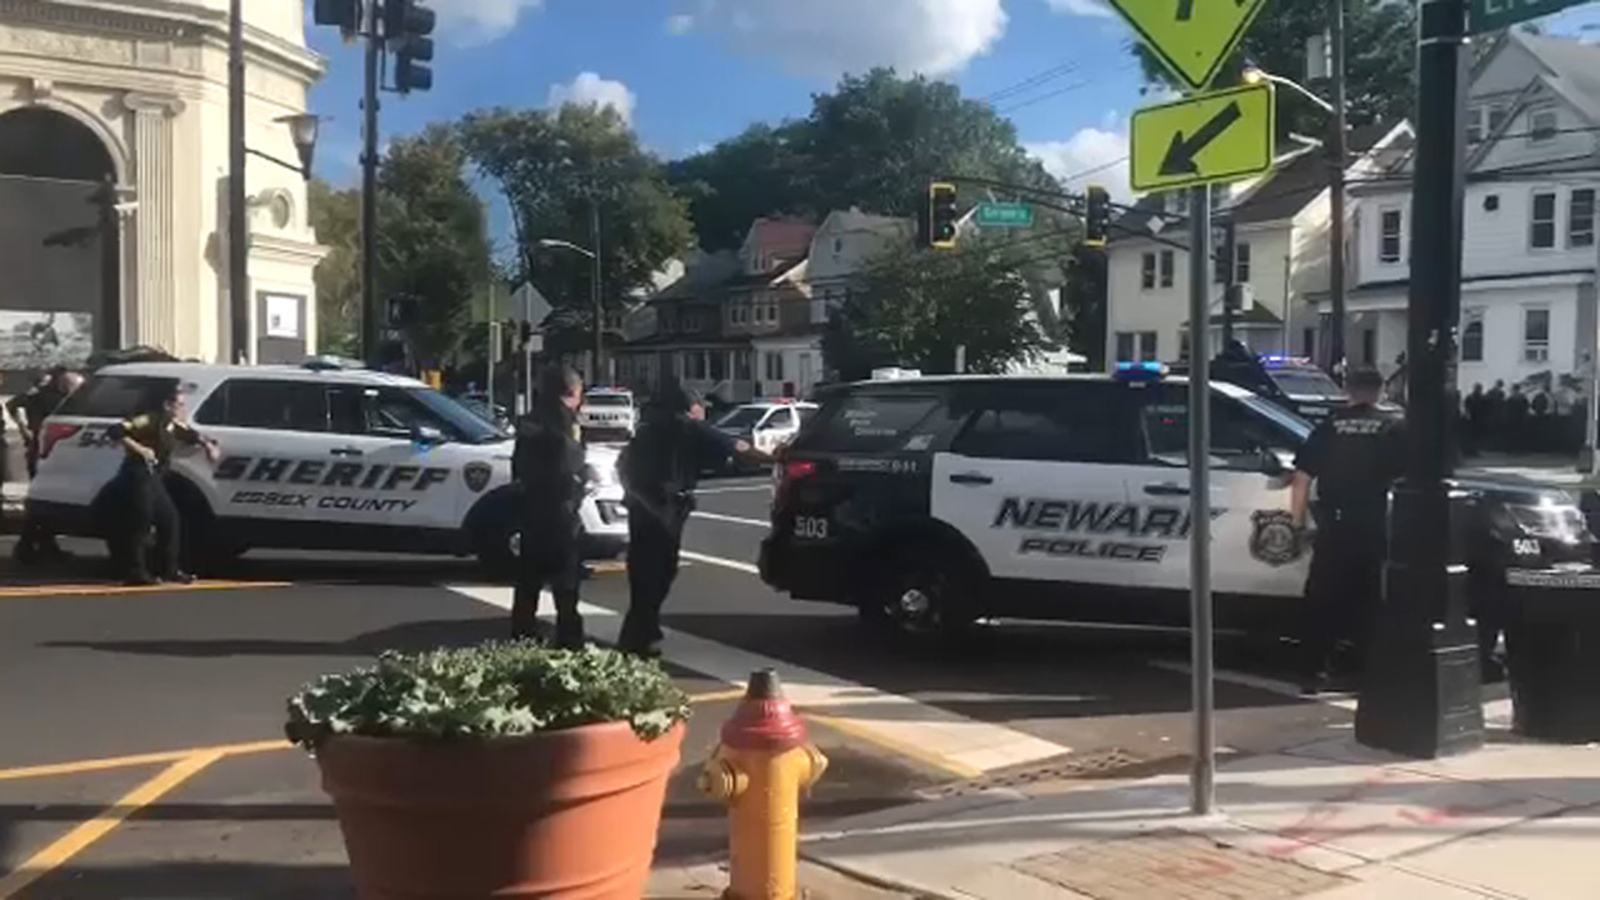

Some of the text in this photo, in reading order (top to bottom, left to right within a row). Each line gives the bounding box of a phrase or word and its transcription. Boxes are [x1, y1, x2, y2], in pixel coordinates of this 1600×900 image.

[212, 456, 449, 491] SHERIFF
[230, 491, 416, 512] ESSEX COUNTY
[795, 516, 829, 538] 503
[1016, 537, 1166, 563] POLICE
